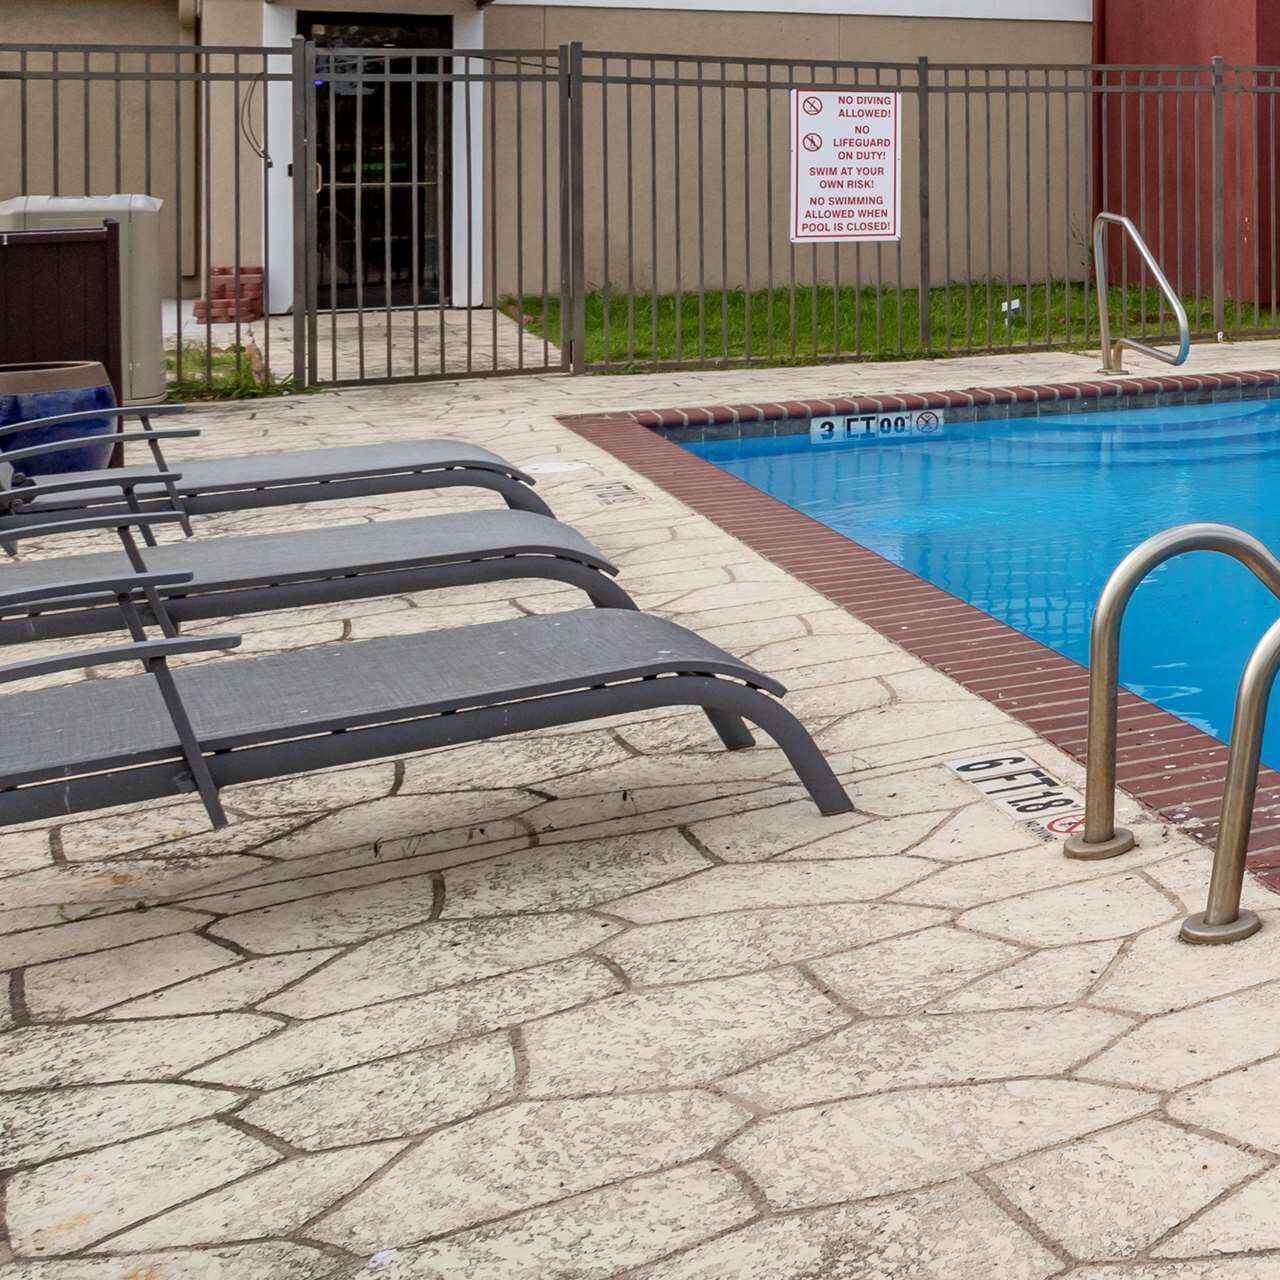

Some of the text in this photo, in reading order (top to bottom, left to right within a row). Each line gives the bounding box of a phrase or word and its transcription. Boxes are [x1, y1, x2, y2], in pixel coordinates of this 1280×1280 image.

[838, 96, 891, 105] NO DIVING
[838, 109, 891, 118] ALLOWED!
[855, 126, 869, 134] NO
[834, 139, 890, 147] LIFEGUARD
[838, 152, 885, 160] ON DUTY!
[809, 167, 884, 176] SWIM AT YOUR
[820, 180, 874, 189] OWN RISK!
[810, 196, 883, 205] NO SWIMMING
[805, 210, 854, 218] ALLOWED
[802, 222, 890, 232] POOL IS CLOSED!
[956, 757, 1026, 772] 6
[971, 770, 1060, 794] FT
